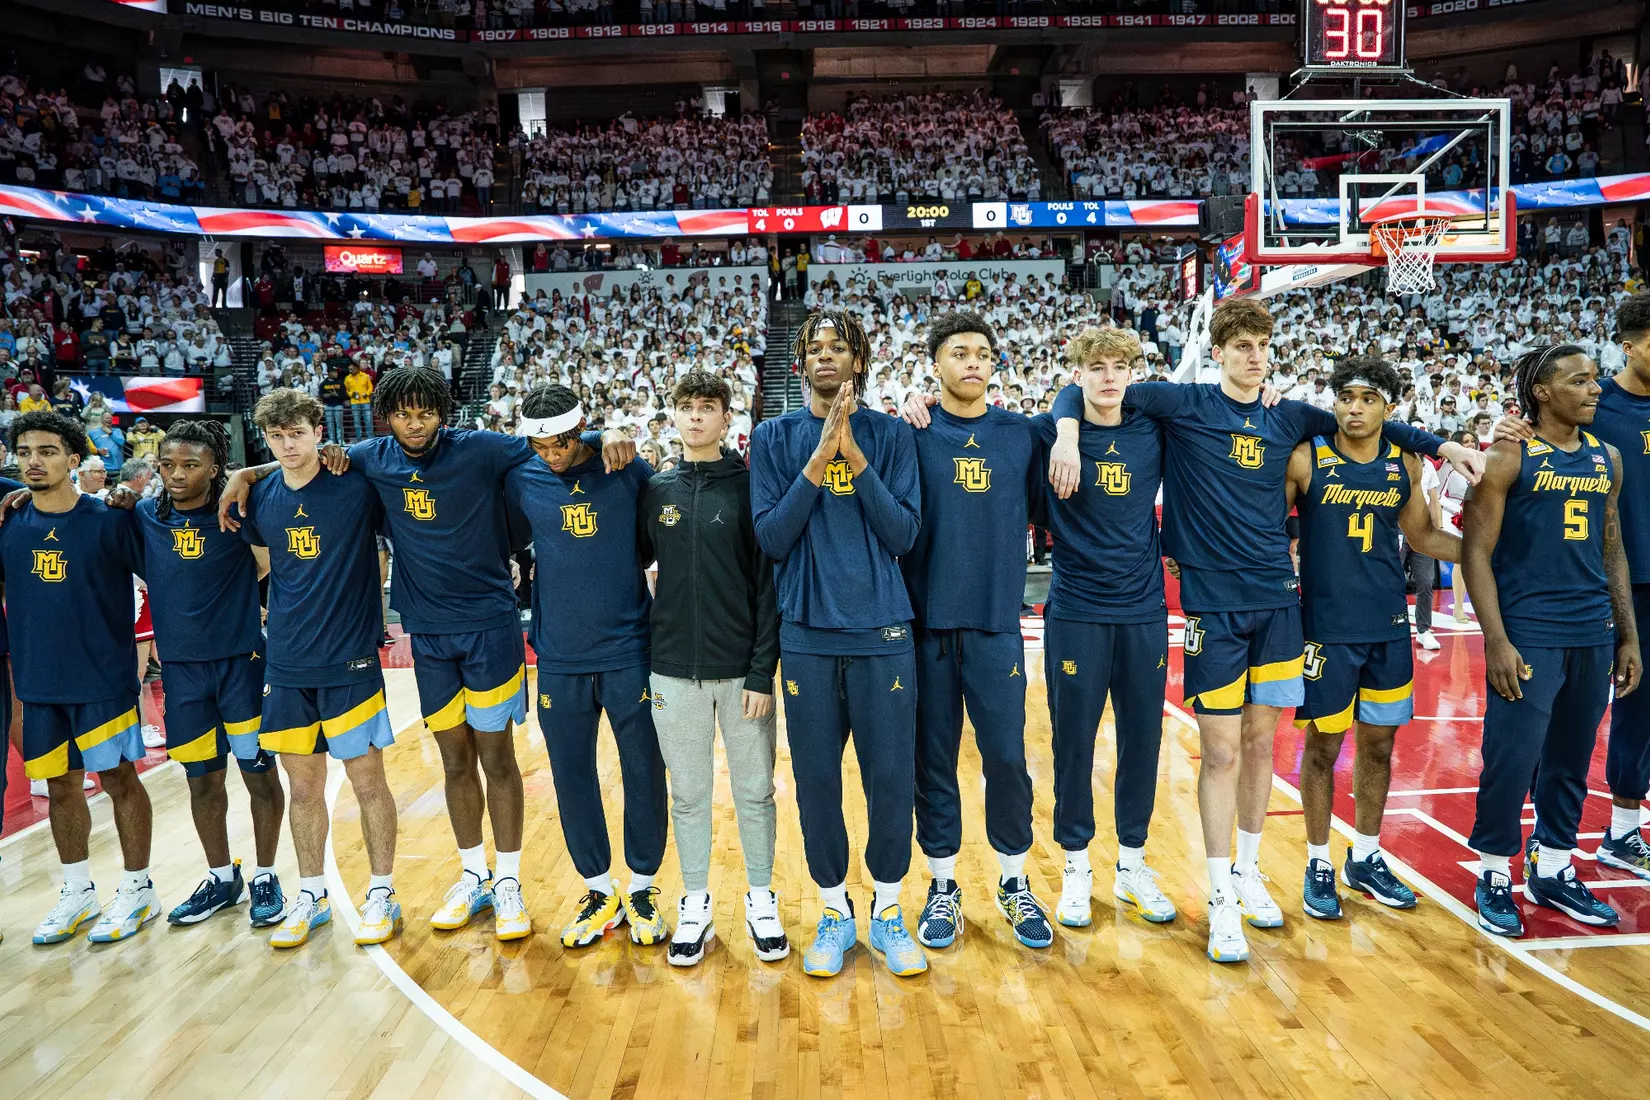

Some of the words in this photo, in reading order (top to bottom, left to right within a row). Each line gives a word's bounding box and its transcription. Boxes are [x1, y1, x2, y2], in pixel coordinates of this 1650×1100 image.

[186, 2, 252, 20] MEN'S
[260, 10, 293, 24] BIG
[299, 15, 337, 28] TEN
[344, 19, 456, 40] CHAMPIONS
[477, 29, 516, 40] 1907
[530, 28, 569, 39] 1908
[585, 25, 621, 37] 1912
[638, 24, 675, 35] 1913
[691, 22, 728, 33] 1914
[745, 21, 782, 32] 1916
[799, 20, 835, 31] 1918
[851, 19, 888, 30] 1921
[905, 18, 943, 29] 1923
[957, 18, 997, 28] 1924
[1010, 16, 1049, 27] 1929
[1063, 16, 1102, 26] 1935
[1116, 15, 1152, 26] 1941
[1168, 15, 1206, 25] 1947
[1218, 14, 1259, 25] 2002
[1431, 0, 1478, 15] 2020
[1325, 8, 1382, 58] 30
[752, 208, 769, 217] TOL
[776, 207, 803, 217] FOULS
[859, 213, 869, 224] 0
[907, 205, 949, 218] 20:00
[986, 210, 996, 221] 0
[1010, 204, 1033, 225] MU
[1047, 202, 1074, 211] FOULS
[1083, 202, 1100, 210] TOL
[1056, 212, 1067, 224] 0
[1086, 211, 1097, 224] 4
[755, 218, 766, 231] 4
[783, 217, 795, 230] 0
[920, 218, 936, 228] 1ST
[340, 250, 386, 267] Quartz
[1229, 433, 1265, 469] MU
[822, 460, 856, 496] MU
[952, 457, 992, 493] MU
[1095, 461, 1132, 496] MU
[1532, 470, 1612, 497] Marquette
[402, 488, 437, 521] MU
[1320, 483, 1402, 510] Marquette
[559, 502, 598, 538] MU
[1347, 512, 1374, 553] 4
[1563, 499, 1589, 541] 5
[171, 528, 206, 560] MU
[285, 526, 321, 560] MU
[31, 549, 68, 583] MU
